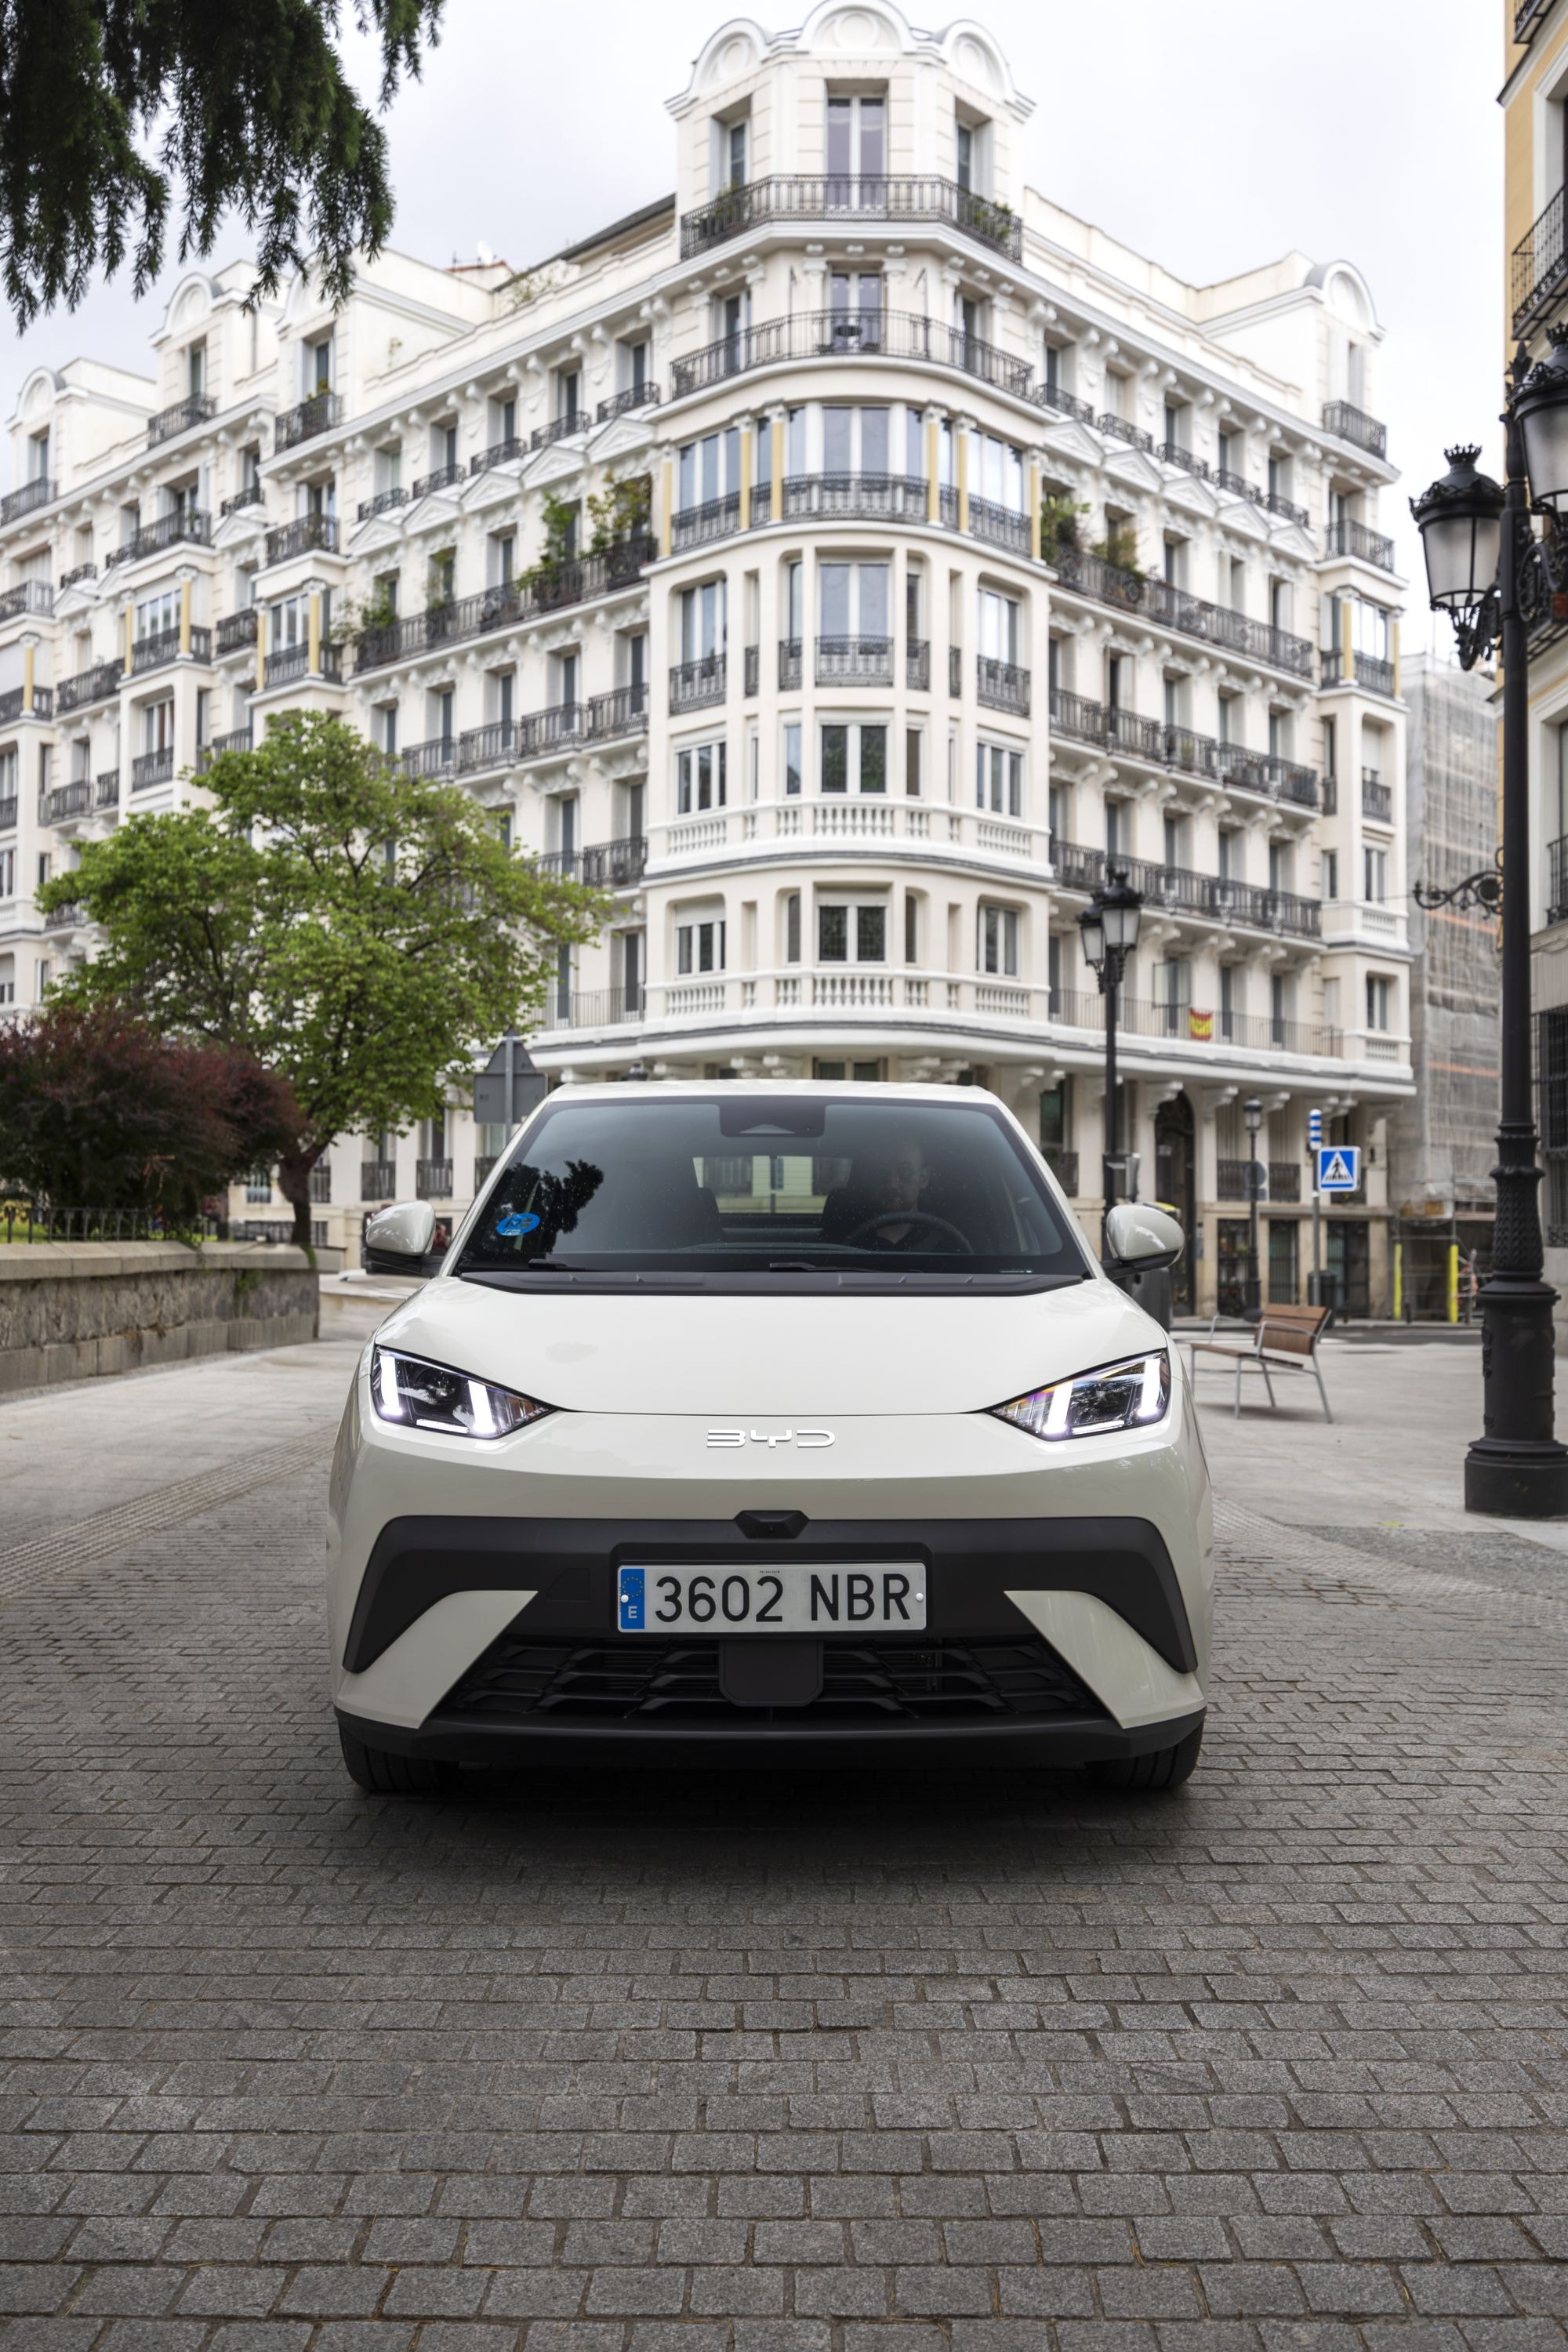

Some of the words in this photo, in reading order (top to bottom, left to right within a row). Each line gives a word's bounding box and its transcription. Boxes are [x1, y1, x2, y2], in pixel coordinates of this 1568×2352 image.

[706, 1428, 836, 1448] BYD
[655, 1575, 783, 1623] 3602
[810, 1573, 910, 1621] NBR
[628, 1606, 637, 1619] E
